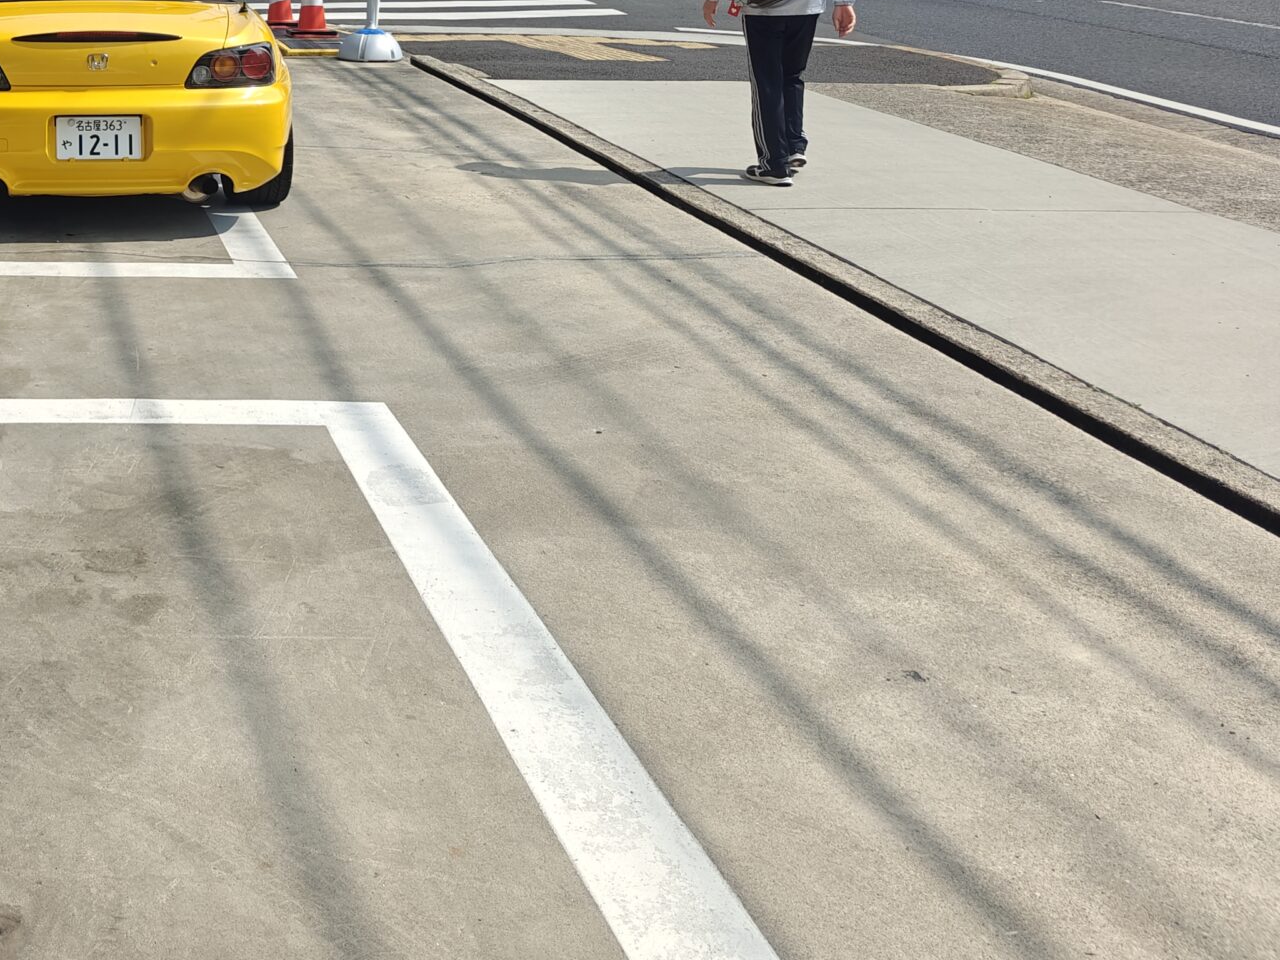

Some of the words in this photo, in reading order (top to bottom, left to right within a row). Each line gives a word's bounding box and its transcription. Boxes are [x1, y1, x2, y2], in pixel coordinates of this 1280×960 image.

[76, 120, 102, 131] 名古屋
[102, 120, 123, 131] 363
[61, 140, 73, 150] や
[78, 134, 133, 156] 12-11
